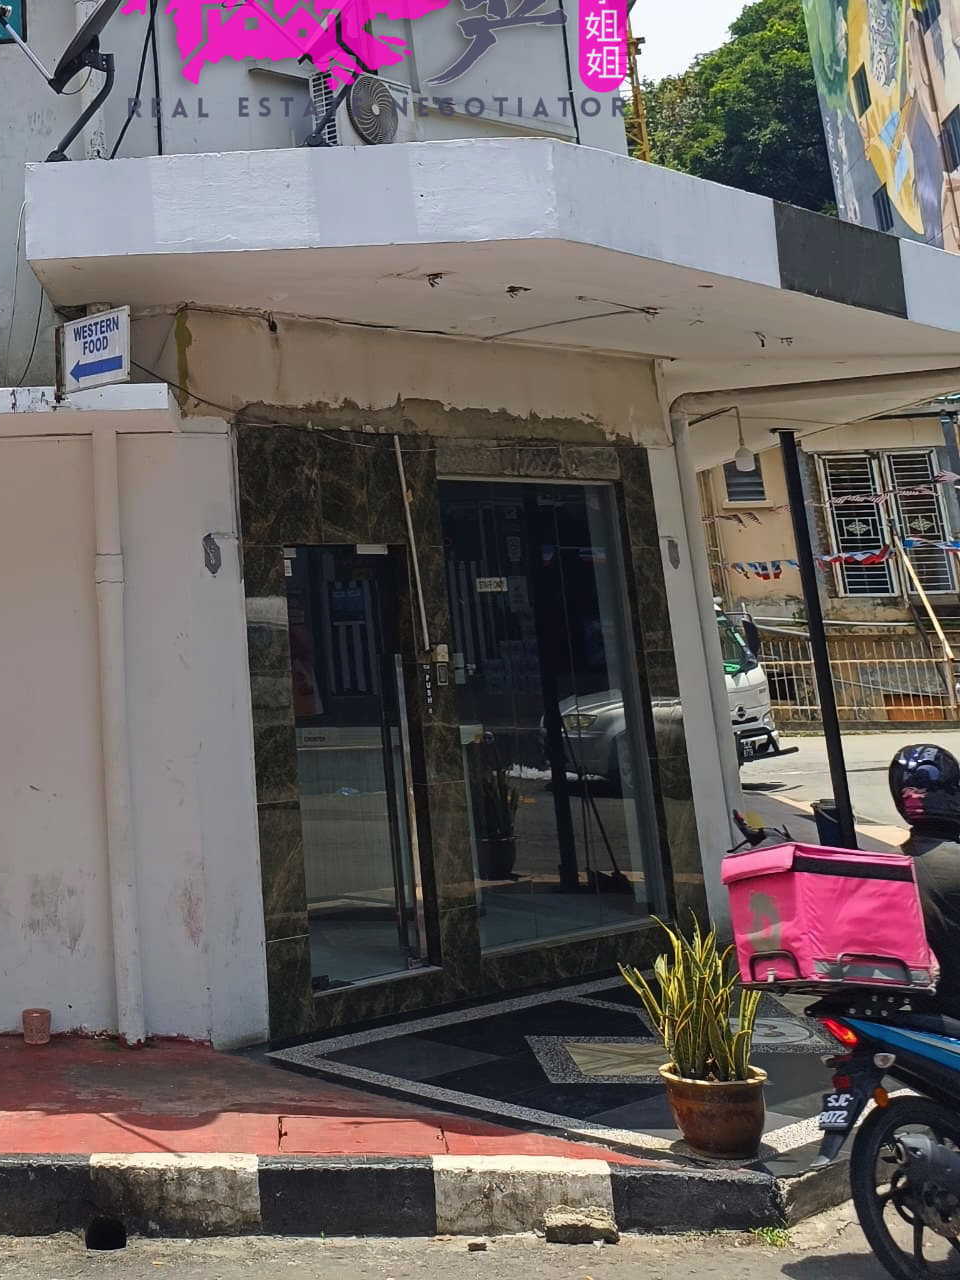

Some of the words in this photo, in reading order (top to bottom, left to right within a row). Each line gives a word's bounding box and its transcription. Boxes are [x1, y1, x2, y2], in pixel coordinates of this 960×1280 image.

[73, 315, 120, 342] WESTERN
[82, 335, 109, 356] FOOD
[425, 674, 433, 704] PUSH
[820, 1110, 848, 1123] 3072
